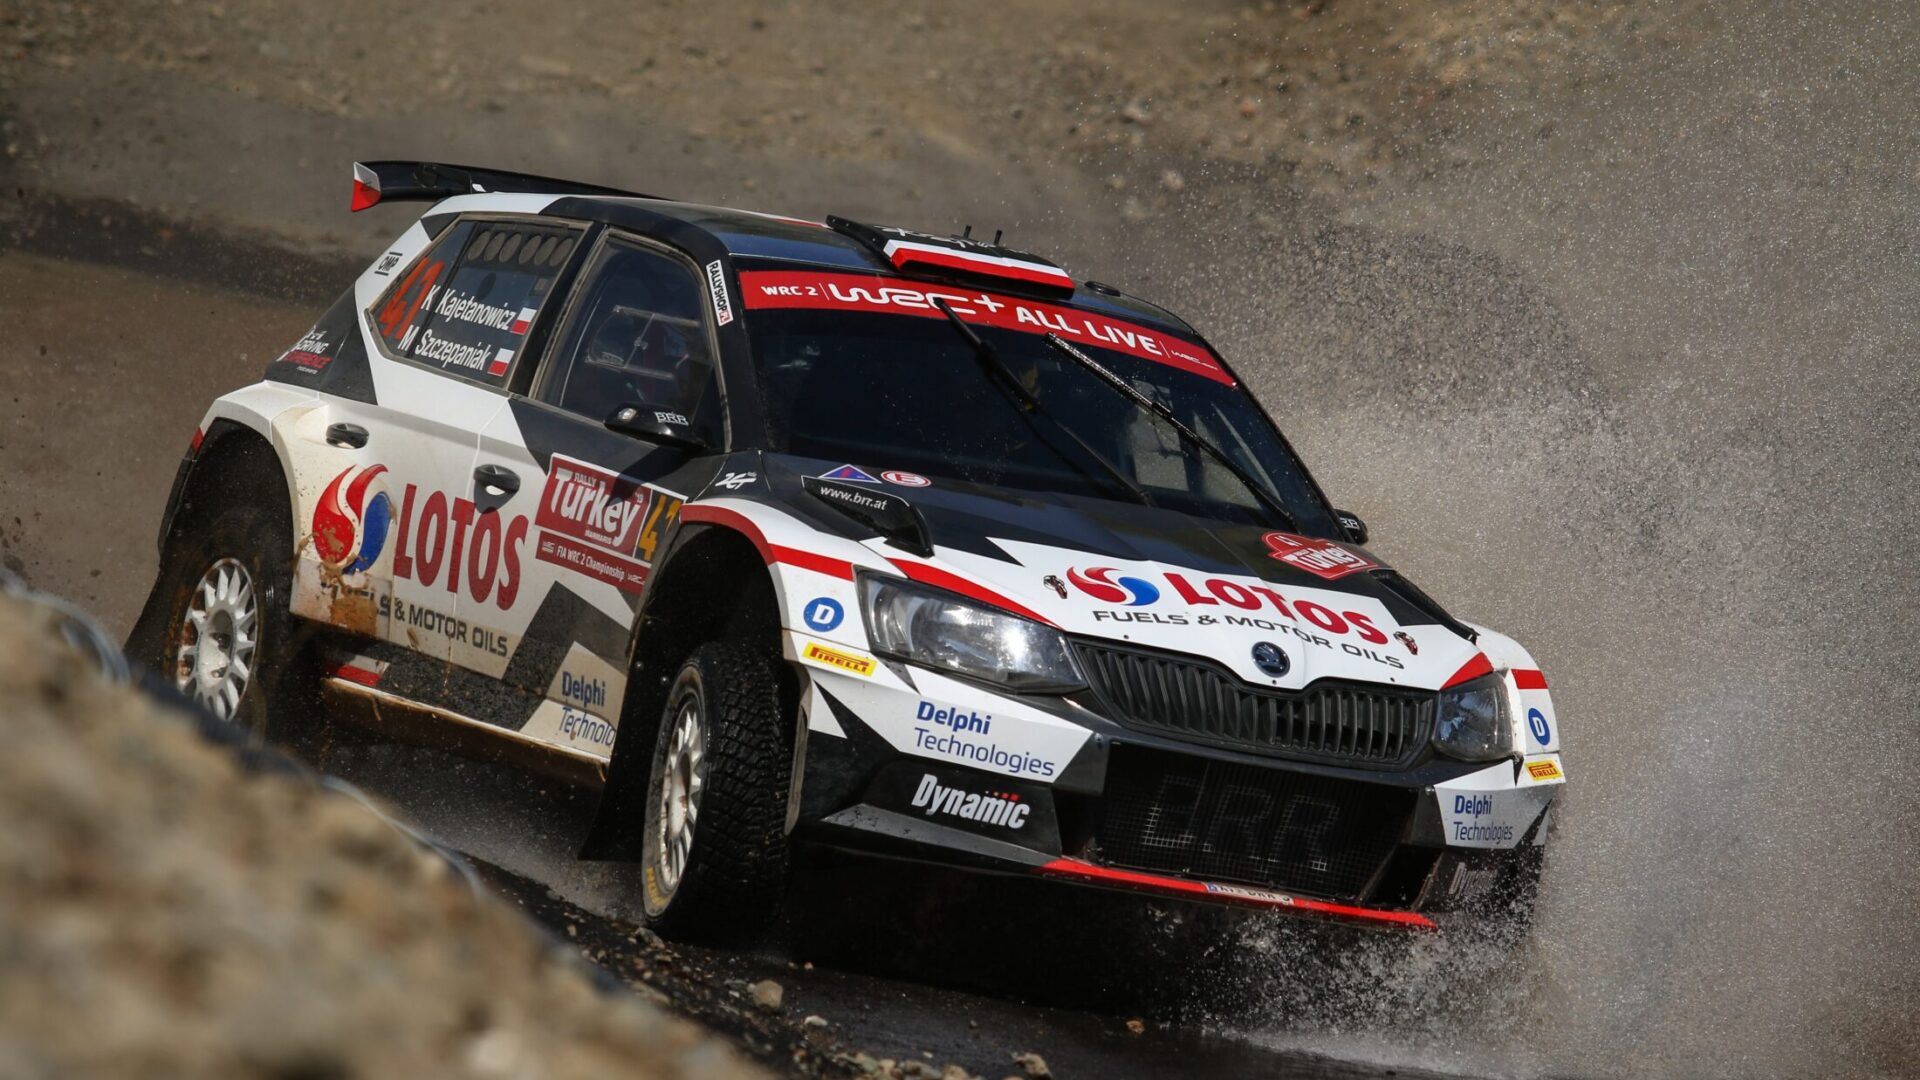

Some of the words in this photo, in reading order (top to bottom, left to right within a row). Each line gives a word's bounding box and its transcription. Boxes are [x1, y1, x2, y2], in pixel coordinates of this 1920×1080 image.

[378, 256, 446, 341] 41
[420, 284, 441, 311] K
[435, 288, 517, 331] Kajetanowicz
[760, 285, 803, 296] WRC
[807, 286, 819, 296] 2
[1016, 306, 1081, 335] ALL
[1084, 320, 1162, 356] LIVE
[397, 324, 420, 352] M
[415, 329, 492, 371] Szczepaniak
[653, 411, 689, 426] BRR
[555, 467, 642, 547] Turkey
[820, 485, 888, 511] www.brr.at
[393, 483, 530, 611] LOTOS
[556, 545, 567, 559] FIA
[567, 547, 581, 564] WRC
[585, 555, 625, 583] Championship
[394, 597, 406, 622] &
[408, 604, 467, 644] MOTOR
[471, 626, 508, 657] OILS
[1163, 572, 1389, 645] LOTOS
[809, 646, 870, 673] PIRELLI
[1092, 610, 1190, 626] FUELS
[1197, 614, 1220, 625] &
[1224, 615, 1333, 650] MOTOR
[1341, 643, 1405, 670] OILS
[562, 671, 606, 708] Delphi
[916, 701, 992, 735] Delphi
[914, 727, 1056, 777] Technologies
[911, 773, 1030, 829] Dynamic
[1454, 795, 1492, 818] Delphi
[1453, 822, 1514, 845] Technologies
